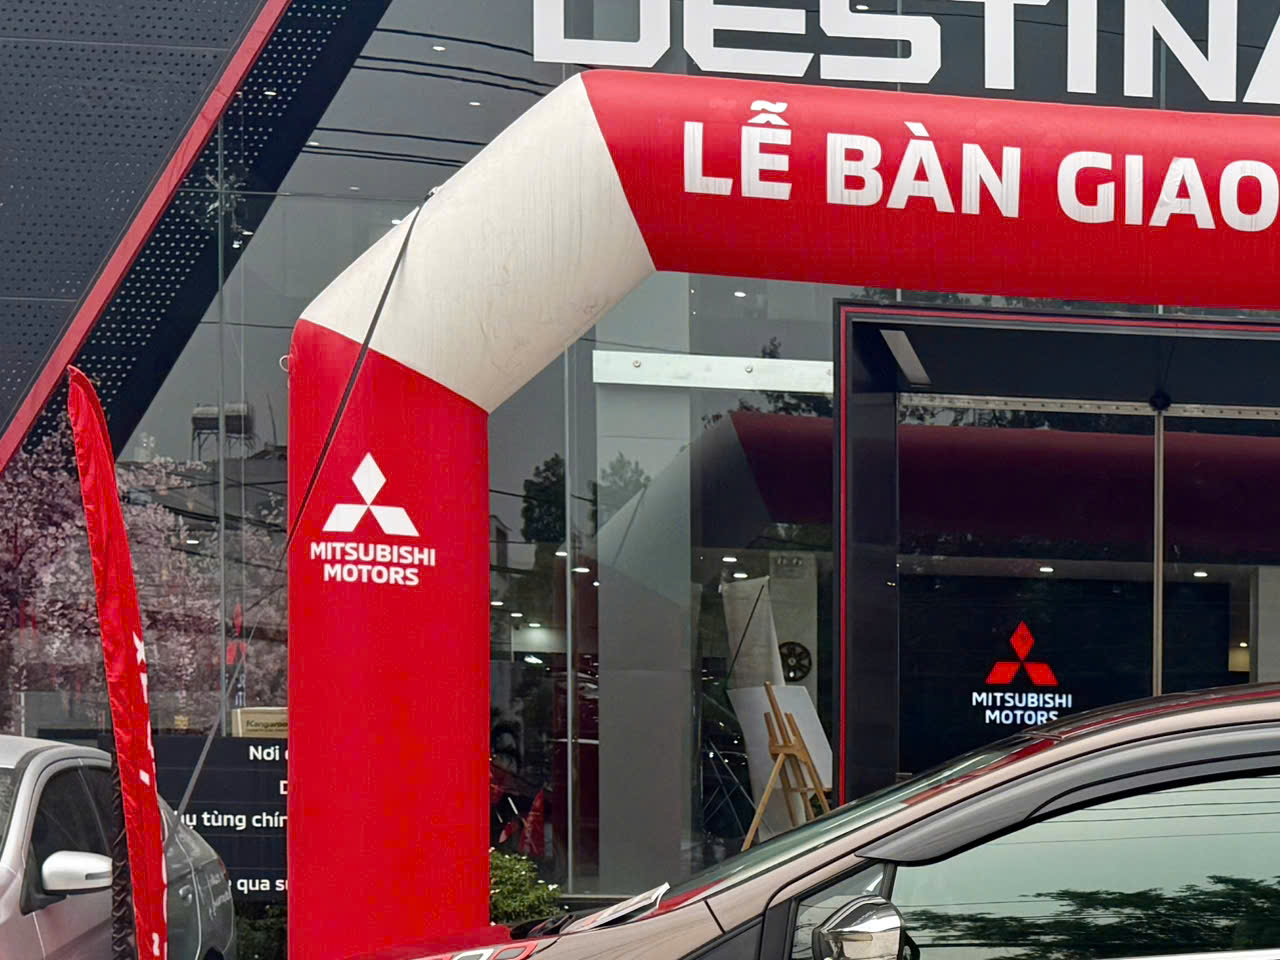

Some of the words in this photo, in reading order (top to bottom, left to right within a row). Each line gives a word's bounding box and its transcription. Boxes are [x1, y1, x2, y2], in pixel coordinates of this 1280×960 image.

[683, 100, 793, 200] LỄ
[826, 122, 1021, 218] BÀN
[1056, 150, 1280, 232] GIAO
[310, 541, 436, 566] MITSUBISHI
[323, 564, 419, 586] MOTORS
[972, 692, 1072, 708] MITSUBISHI
[985, 710, 1059, 725] MOTORS
[249, 745, 280, 761] Nơi
[201, 810, 247, 830] tùng
[237, 879, 271, 894] qua
